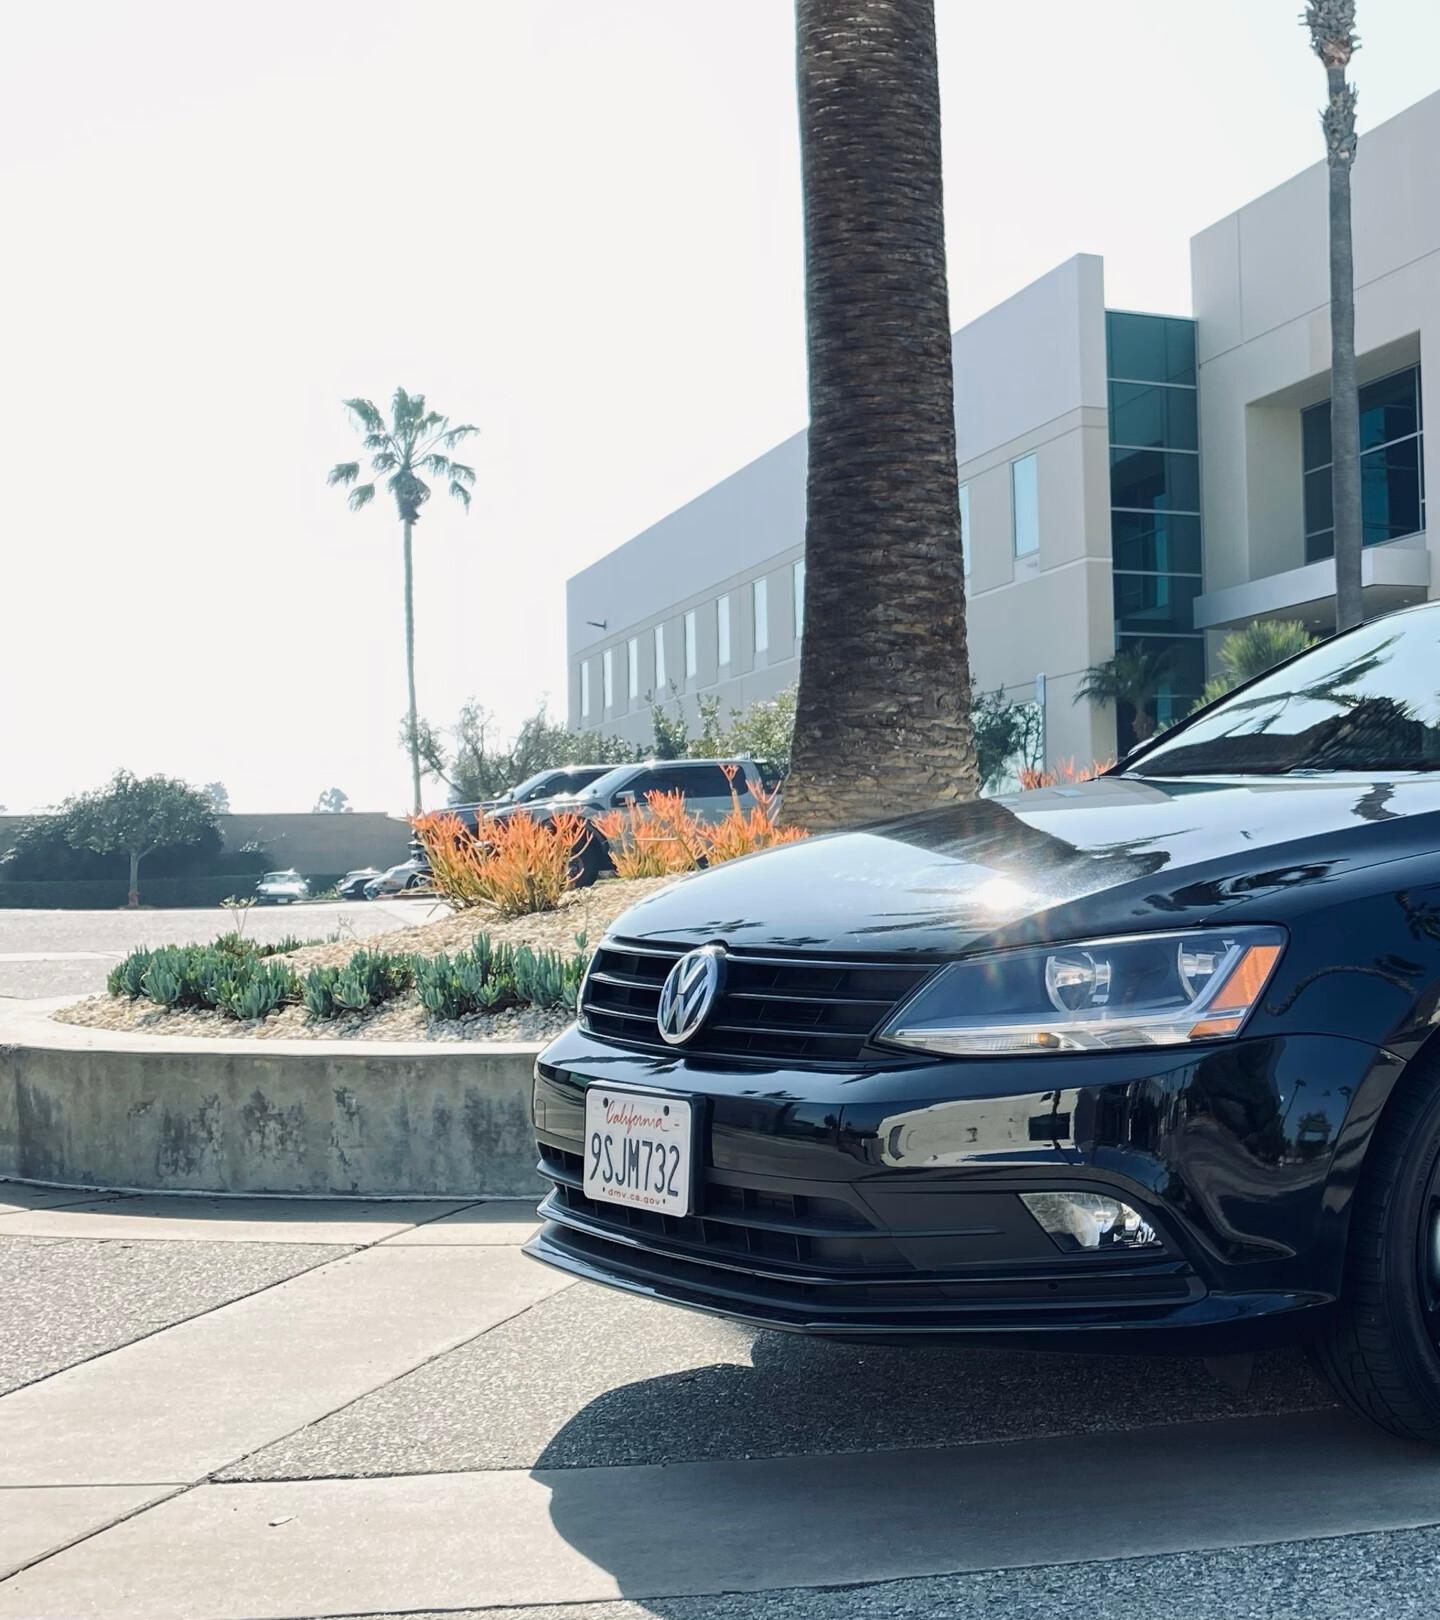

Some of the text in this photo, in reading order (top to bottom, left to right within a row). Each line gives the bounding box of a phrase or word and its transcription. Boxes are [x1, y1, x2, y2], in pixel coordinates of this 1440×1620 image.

[606, 1100, 670, 1134] California
[589, 1132, 680, 1197] 9SJM732
[607, 1188, 661, 1206] dmv.ca.gov
